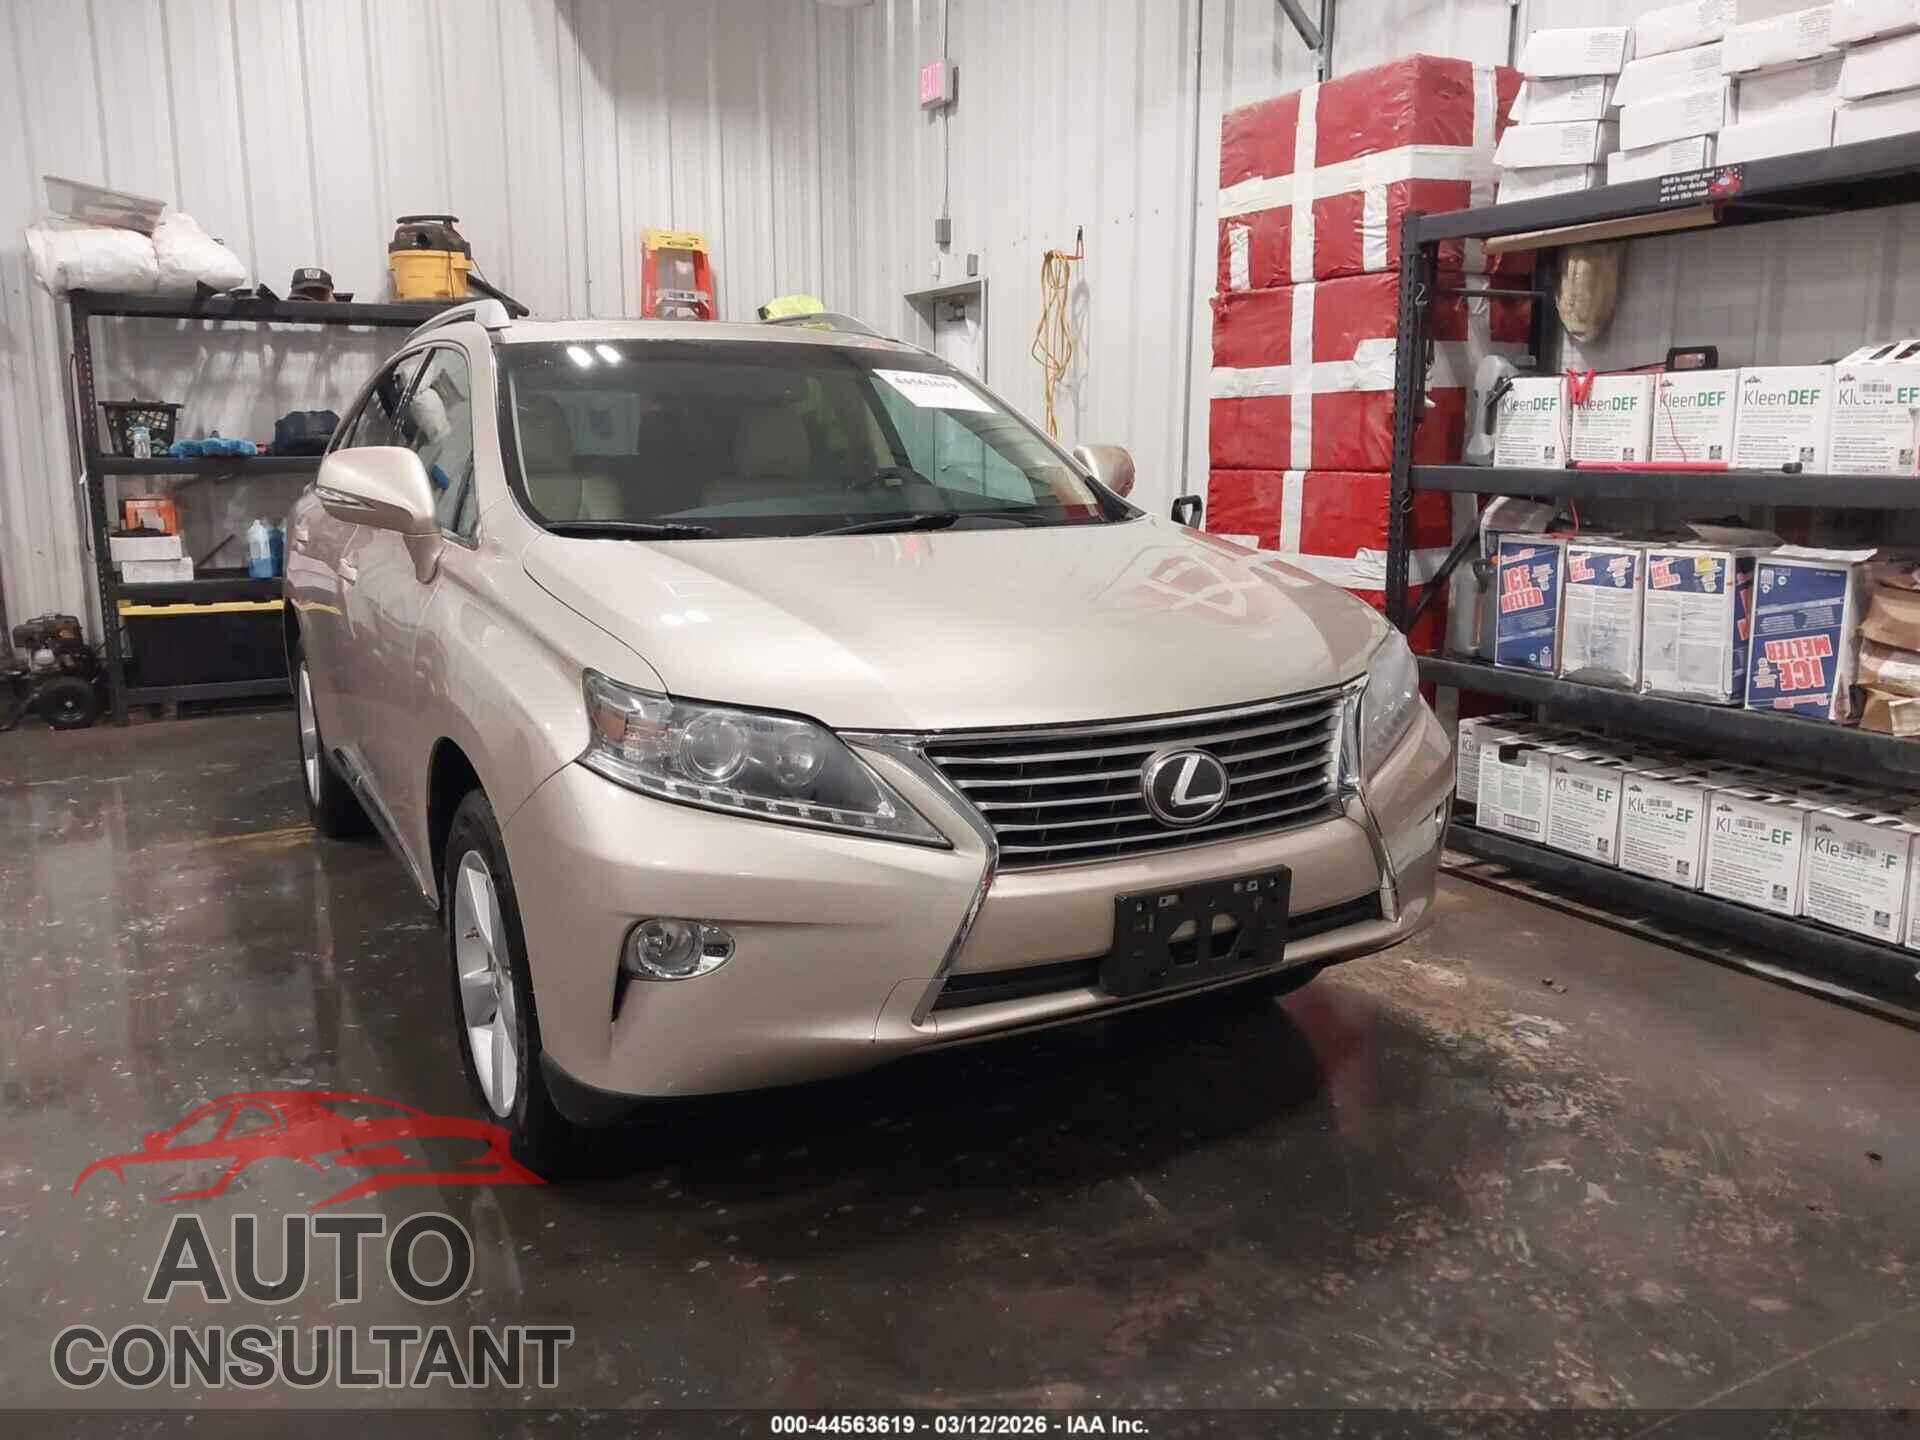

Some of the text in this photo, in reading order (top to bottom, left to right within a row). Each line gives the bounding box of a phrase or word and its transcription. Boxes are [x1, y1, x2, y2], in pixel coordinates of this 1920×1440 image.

[921, 63, 943, 99] EXIT
[1502, 396, 1557, 411] KleenDEF
[1659, 391, 1726, 408] KleenDEF
[1743, 389, 1821, 406] KleenDEF
[1503, 564, 1532, 593] ICE
[1501, 587, 1544, 613] MELTER
[1765, 634, 1833, 663] MELTER
[1777, 657, 1825, 690] ICE
